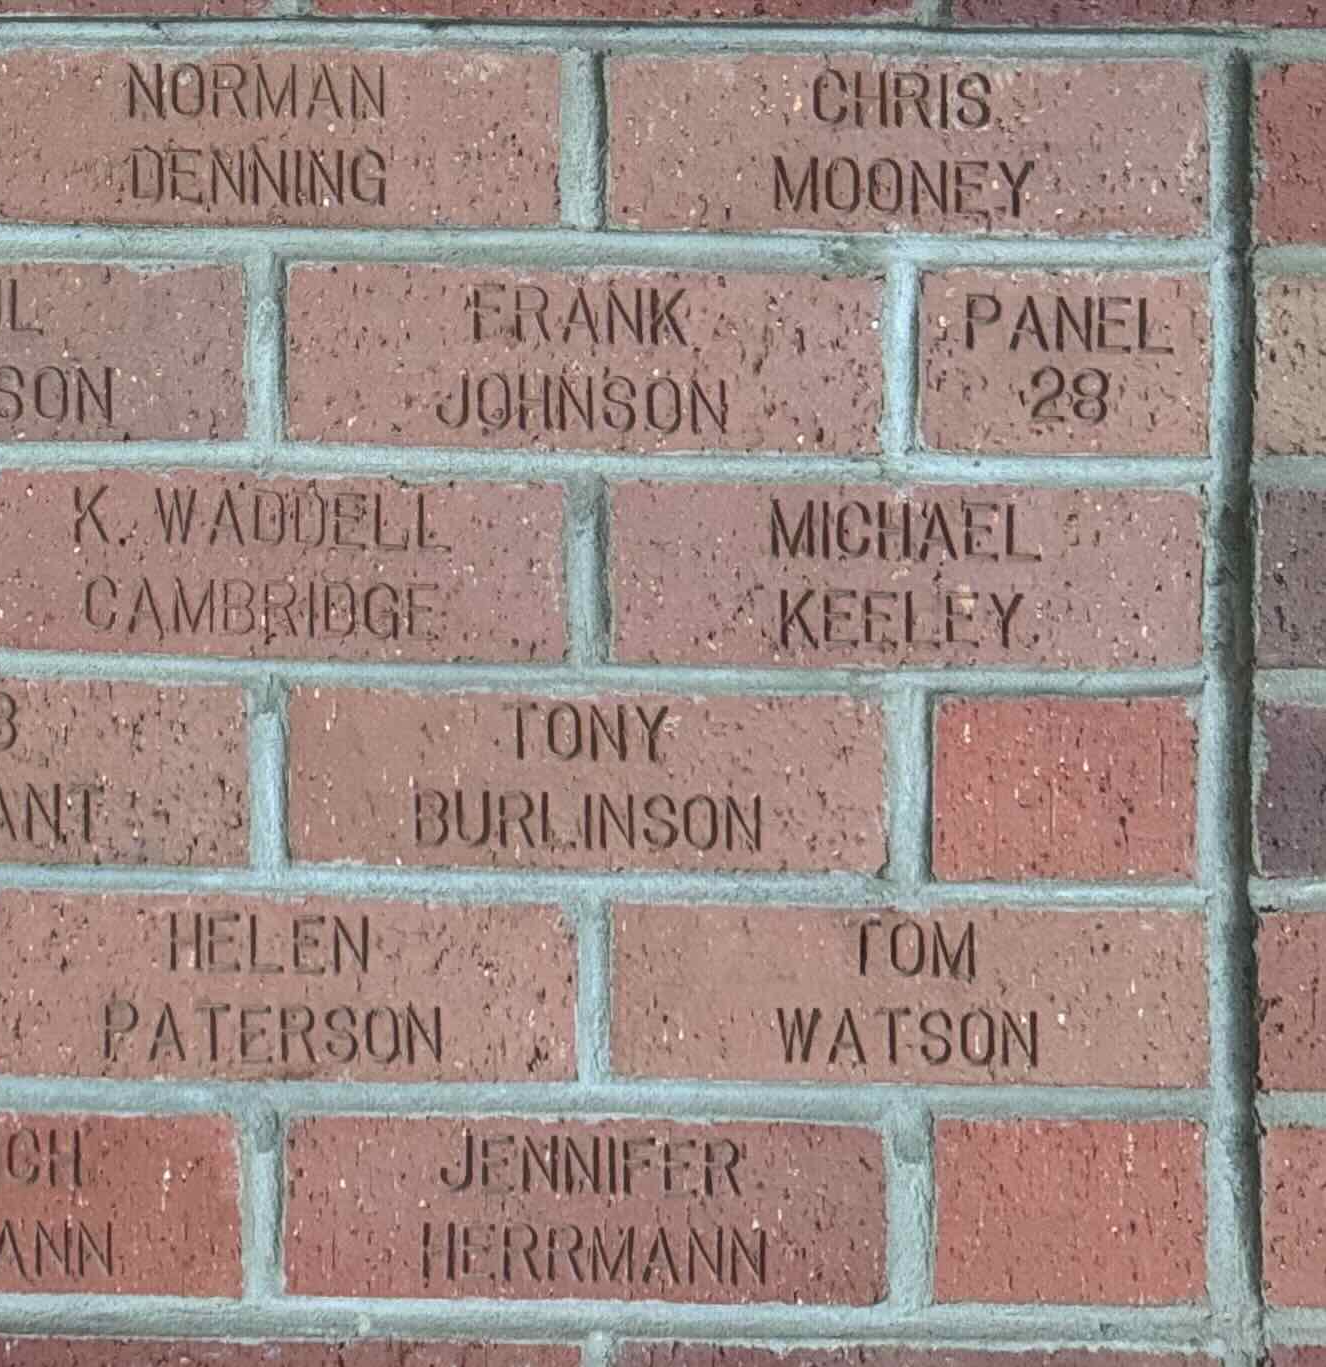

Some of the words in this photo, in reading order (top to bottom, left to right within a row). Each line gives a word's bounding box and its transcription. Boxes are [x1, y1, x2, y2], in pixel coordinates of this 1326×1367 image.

[128, 62, 386, 118] NORMAN
[813, 69, 991, 131] CHRIS
[129, 148, 386, 207] DENNING
[773, 156, 1034, 218] MOONEY
[472, 283, 688, 347] FRANK
[963, 292, 1173, 354] PANEL
[437, 374, 728, 435] JOHNSON
[1029, 367, 1109, 423] 28
[156, 487, 453, 550] WADDELL
[769, 499, 1042, 562] MICHAEL
[84, 575, 440, 640] CAMBRIDGE
[779, 589, 1025, 650] KEELEY
[510, 702, 669, 761] TONY
[416, 790, 762, 852] BURLINSON
[169, 911, 370, 974] HELEN
[858, 921, 974, 980] TOM
[102, 1000, 441, 1064] PATERSON
[778, 1008, 1038, 1067] WATSON
[439, 1133, 742, 1196] JENNIFER
[423, 1222, 766, 1288] HERRMANN
